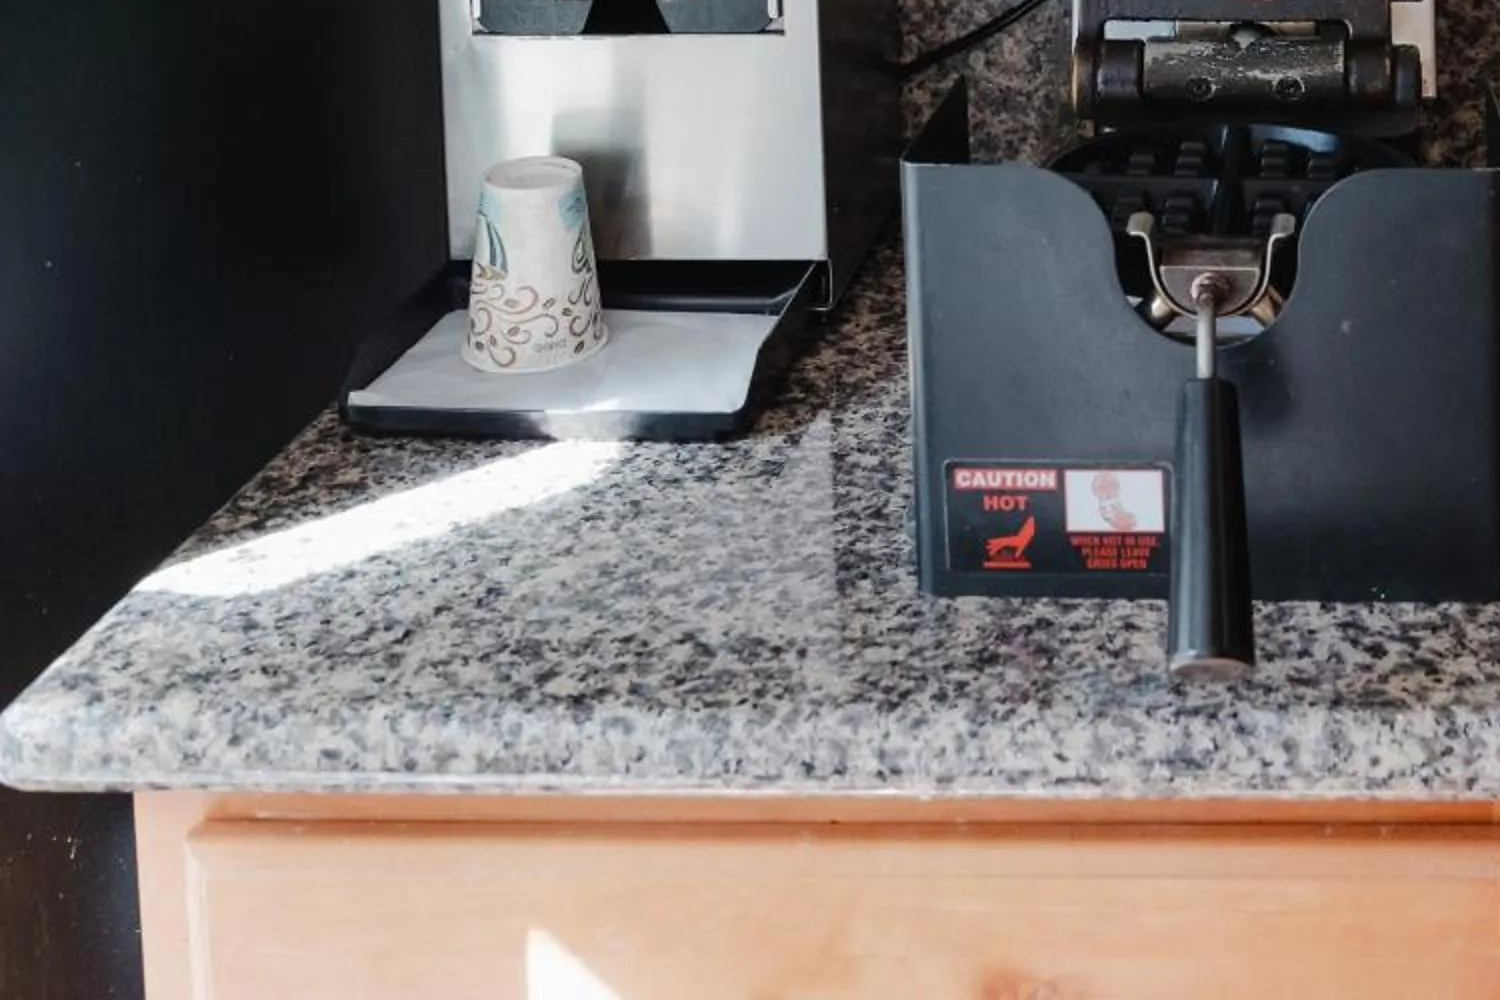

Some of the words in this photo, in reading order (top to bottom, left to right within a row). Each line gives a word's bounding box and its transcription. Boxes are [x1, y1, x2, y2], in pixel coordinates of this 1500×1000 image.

[955, 470, 1057, 488] CAUTION
[983, 495, 1029, 511] HOT
[1082, 546, 1118, 557] PLEASE
[1121, 546, 1150, 557] LEAVE
[1119, 557, 1147, 569] OPEN
